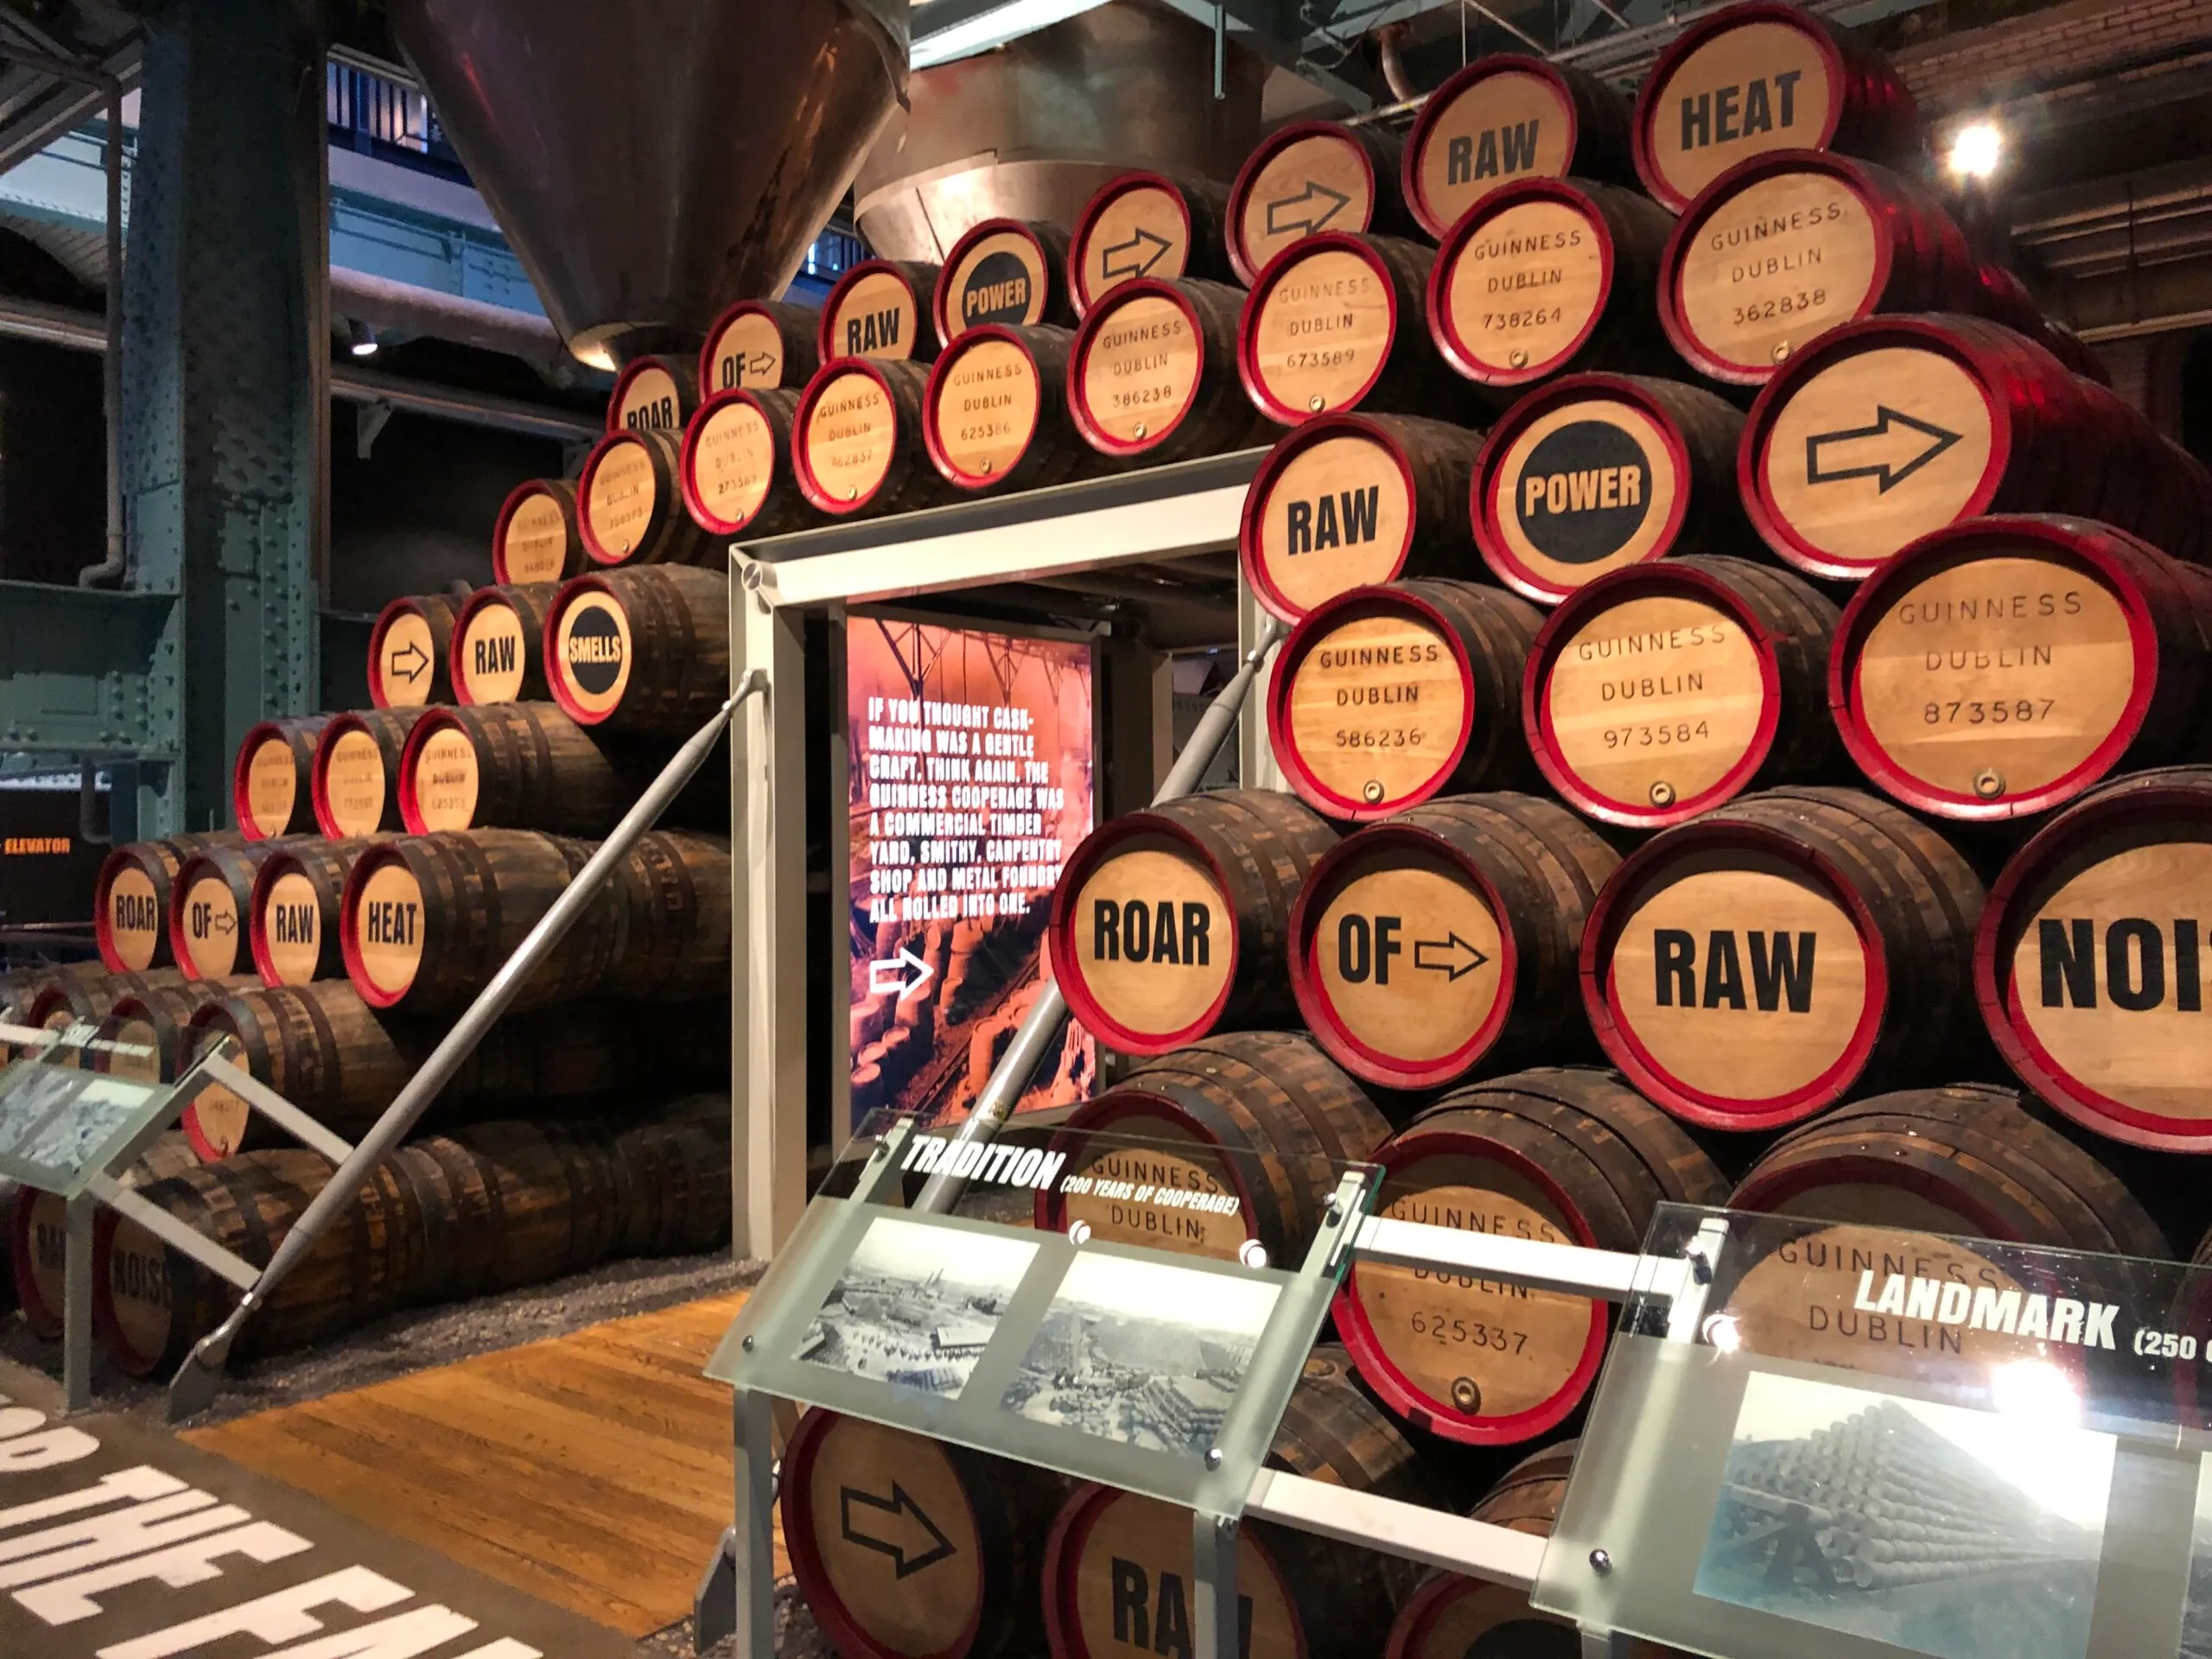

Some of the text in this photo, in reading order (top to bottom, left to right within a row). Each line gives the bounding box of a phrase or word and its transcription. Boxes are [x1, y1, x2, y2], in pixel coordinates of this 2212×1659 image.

[1681, 70, 1802, 151] HEAT
[1447, 119, 1540, 185] RAW
[1711, 202, 1842, 251] GUINNESS
[1474, 229, 1582, 261] GUINNESS
[1487, 268, 1563, 293] DUBLIN
[1732, 248, 1822, 283] DUBLIN
[966, 277, 1027, 315] POWER
[1279, 277, 1370, 304] GUINNESS
[1481, 307, 1562, 330] 738264
[1732, 289, 1827, 325] 362838
[847, 308, 899, 357] RAW
[1103, 321, 1183, 348] GUINNESS
[1290, 313, 1353, 336] DUBLIN
[722, 352, 747, 389] OF
[954, 363, 1022, 386] GUINNESS
[1113, 353, 1169, 377] DUBLIN
[1287, 348, 1355, 369] 673589
[821, 394, 880, 419] GUINNESS
[963, 394, 1012, 412] DUBLIN
[1112, 385, 1173, 409] 386238
[829, 423, 871, 442] DUBLIN
[1524, 465, 1643, 517] POWER
[1287, 486, 1380, 556] RAW
[1899, 592, 2082, 625] GUINNESS
[475, 636, 516, 674] RAW
[569, 635, 622, 664] SMELLS
[1319, 644, 1440, 669] GUINNESS
[1579, 625, 1727, 662] GUINNESS
[1926, 645, 2053, 671] DUBLIN
[1336, 685, 1420, 707] DUBLIN
[1601, 673, 1705, 702] DUBLIN
[868, 696, 1034, 731] IF YOU THOUGHT CASK-
[1924, 699, 2056, 725] 873587
[868, 726, 1034, 758] MAKING WAS A GENTLE
[1336, 728, 1422, 748] 586236
[1604, 721, 1710, 749] 973584
[926, 757, 970, 782] THINK
[975, 760, 1020, 783] AGAIN.
[1025, 760, 1048, 784] THE
[869, 784, 1065, 810] GUINNESS COOPERAGE WAS
[869, 812, 1042, 837] A COMMERCIAL TIMBER
[4, 838, 71, 855] ELEVATOR
[869, 839, 1062, 866] YARD, SMITHY, CARPENTRY
[869, 864, 1063, 894] SHOP AND METAL FOUNDRY
[116, 894, 156, 931] ROAR
[192, 902, 211, 939] OF
[276, 903, 315, 944] RAW
[368, 901, 417, 945] HEAT
[869, 892, 1030, 924] ALL ROLLED INTO ONE.
[1094, 899, 1210, 966] ROAR
[1338, 913, 1402, 986] OF
[2039, 918, 2212, 1013] NOI
[1654, 929, 1817, 1013] RAW
[900, 1135, 1240, 1217] TRADITION (200 YEARS OF COOPERAGE)
[1092, 1154, 1218, 1193] GUINNESS
[1111, 1205, 1200, 1240] DUBLIN
[1809, 1305, 1962, 1354] DUBLIN
[1854, 1270, 2120, 1350] LANDMARK
[2134, 1328, 2196, 1360] (250
[1411, 1311, 1529, 1355] 625337
